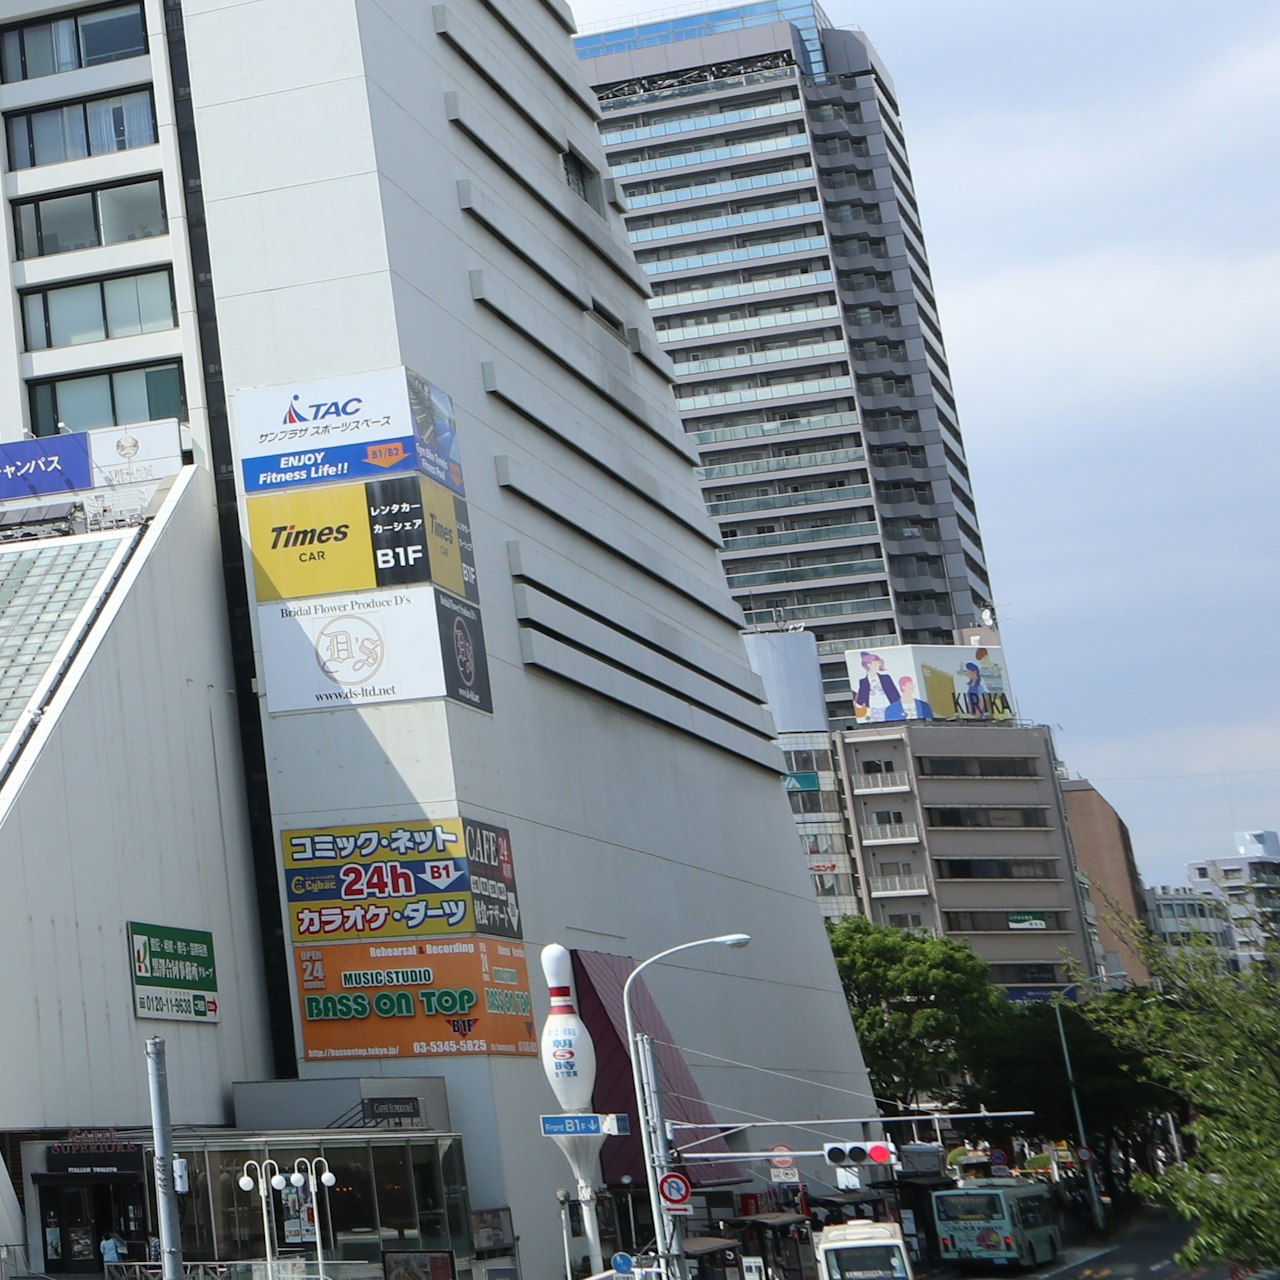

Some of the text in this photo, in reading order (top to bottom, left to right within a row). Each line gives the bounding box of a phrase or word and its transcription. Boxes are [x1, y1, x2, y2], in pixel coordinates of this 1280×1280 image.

[308, 397, 363, 421] TAC
[310, 415, 391, 437] スポーツスペース
[280, 451, 326, 469] ENJOY
[371, 446, 401, 460] B1/B2
[258, 461, 349, 485] Fitness Life!!
[370, 502, 421, 517] レンタカー
[271, 524, 350, 550] Times
[373, 519, 423, 534] カーシェア
[429, 511, 454, 545] Times
[298, 550, 326, 563] CAR
[375, 544, 424, 569] B1F
[461, 562, 477, 585] B1F
[281, 595, 412, 619] Bridal Flower Produce D's
[315, 685, 397, 702] www.ds-ltd.net
[951, 692, 1013, 715] KIRIKA
[290, 824, 458, 861] コミック・ネット
[466, 825, 499, 867] CAFE
[341, 861, 416, 901] 24h
[430, 863, 451, 880] B1
[297, 899, 467, 935] カラオケ・ダーツ
[369, 945, 417, 958] Rehearsal
[426, 942, 475, 956] Recording
[303, 960, 325, 981] 24
[343, 968, 432, 986] MUSIC STUDIO
[305, 992, 370, 1021] BASS
[418, 987, 478, 1016] TOP
[452, 1018, 473, 1033] B1F
[412, 1039, 487, 1054] 03-5345-5825
[545, 1123, 565, 1132] Front
